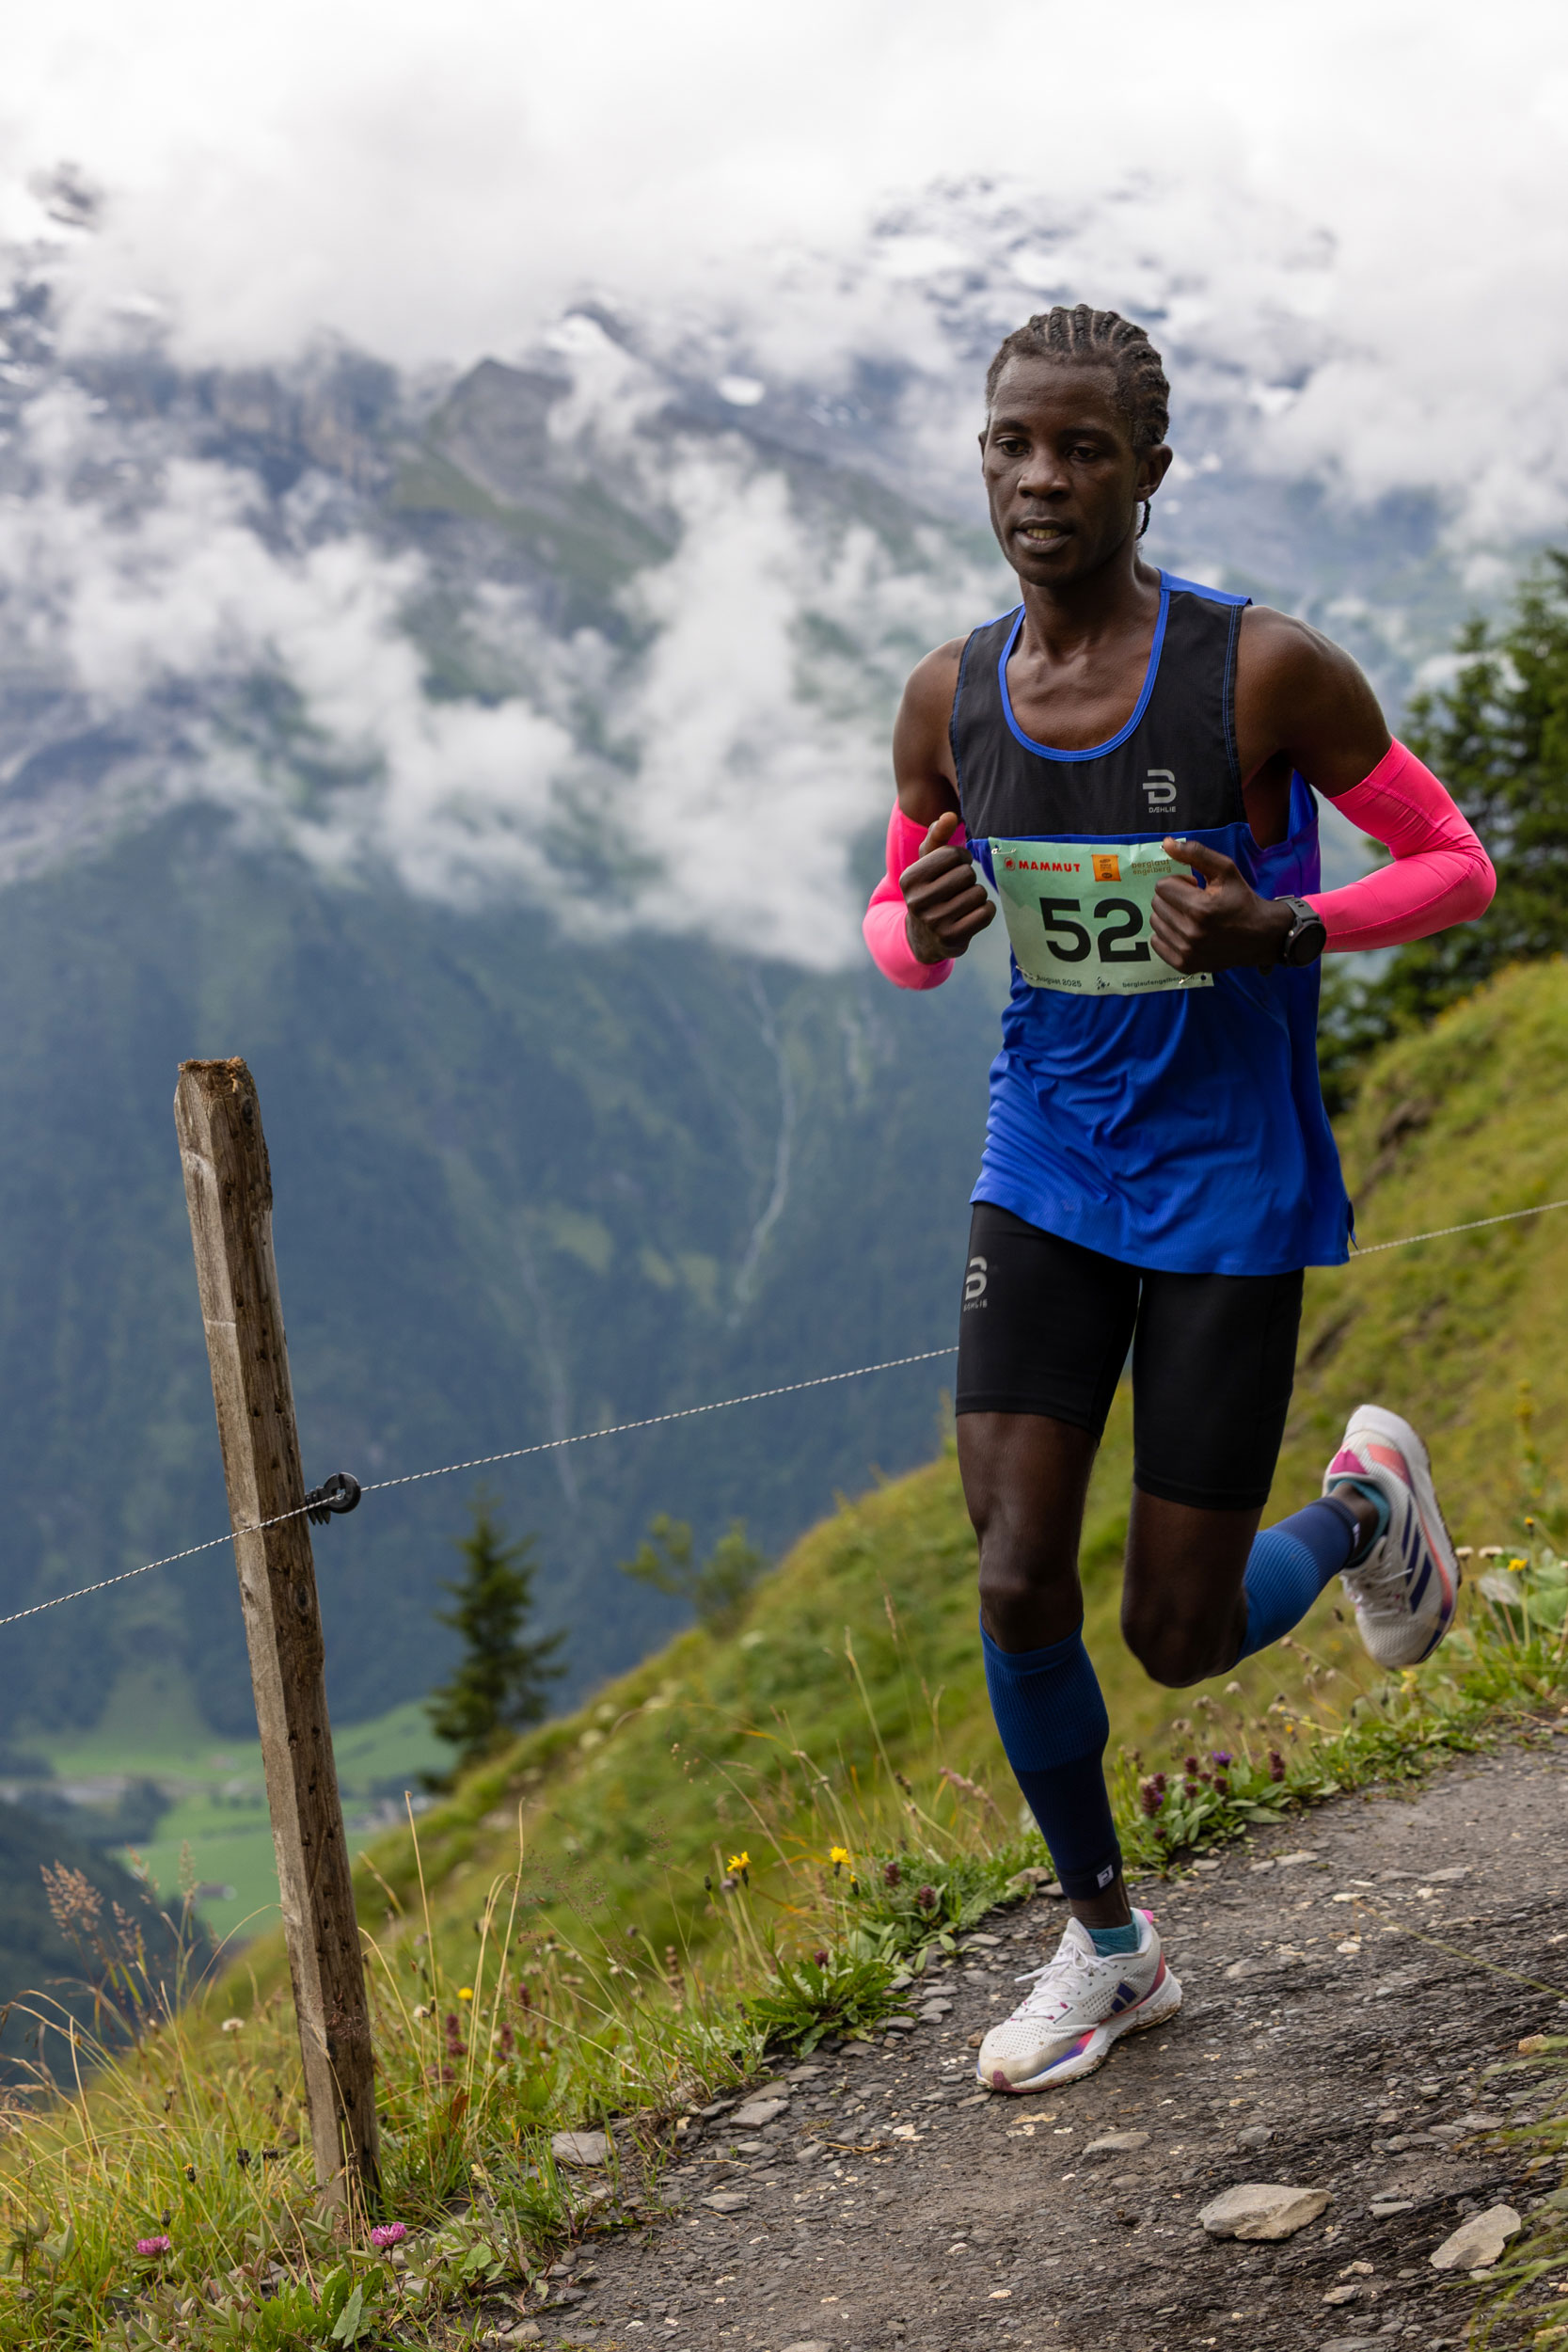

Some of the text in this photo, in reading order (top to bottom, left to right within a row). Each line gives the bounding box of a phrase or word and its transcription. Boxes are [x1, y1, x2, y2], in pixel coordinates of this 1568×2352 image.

[1019, 860, 1081, 873] MAMMUT
[1131, 859, 1170, 869] berglauf
[1132, 866, 1172, 876] engelberg
[1039, 898, 1151, 962] 52
[1062, 978, 1082, 988] 2025
